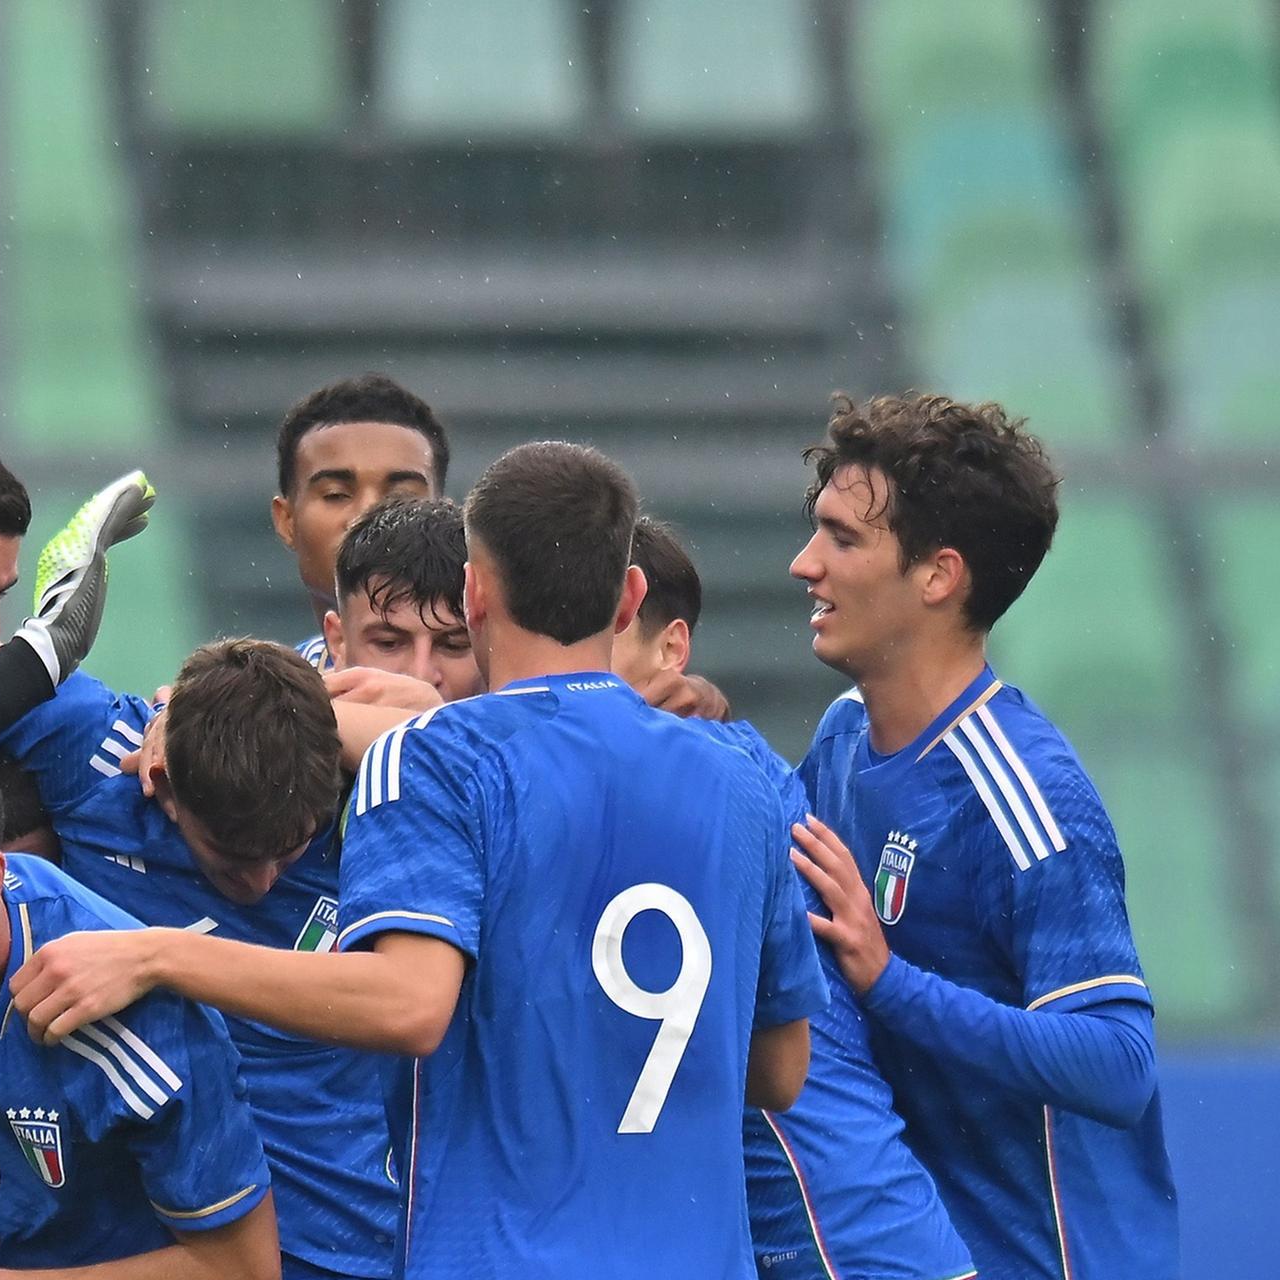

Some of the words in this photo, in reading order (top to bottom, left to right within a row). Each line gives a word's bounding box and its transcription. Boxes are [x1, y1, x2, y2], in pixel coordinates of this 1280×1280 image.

[882, 850, 908, 873] ITALIA
[316, 902, 338, 926] ITA
[590, 883, 712, 1134] 9
[14, 1125, 55, 1145] ITALIA
